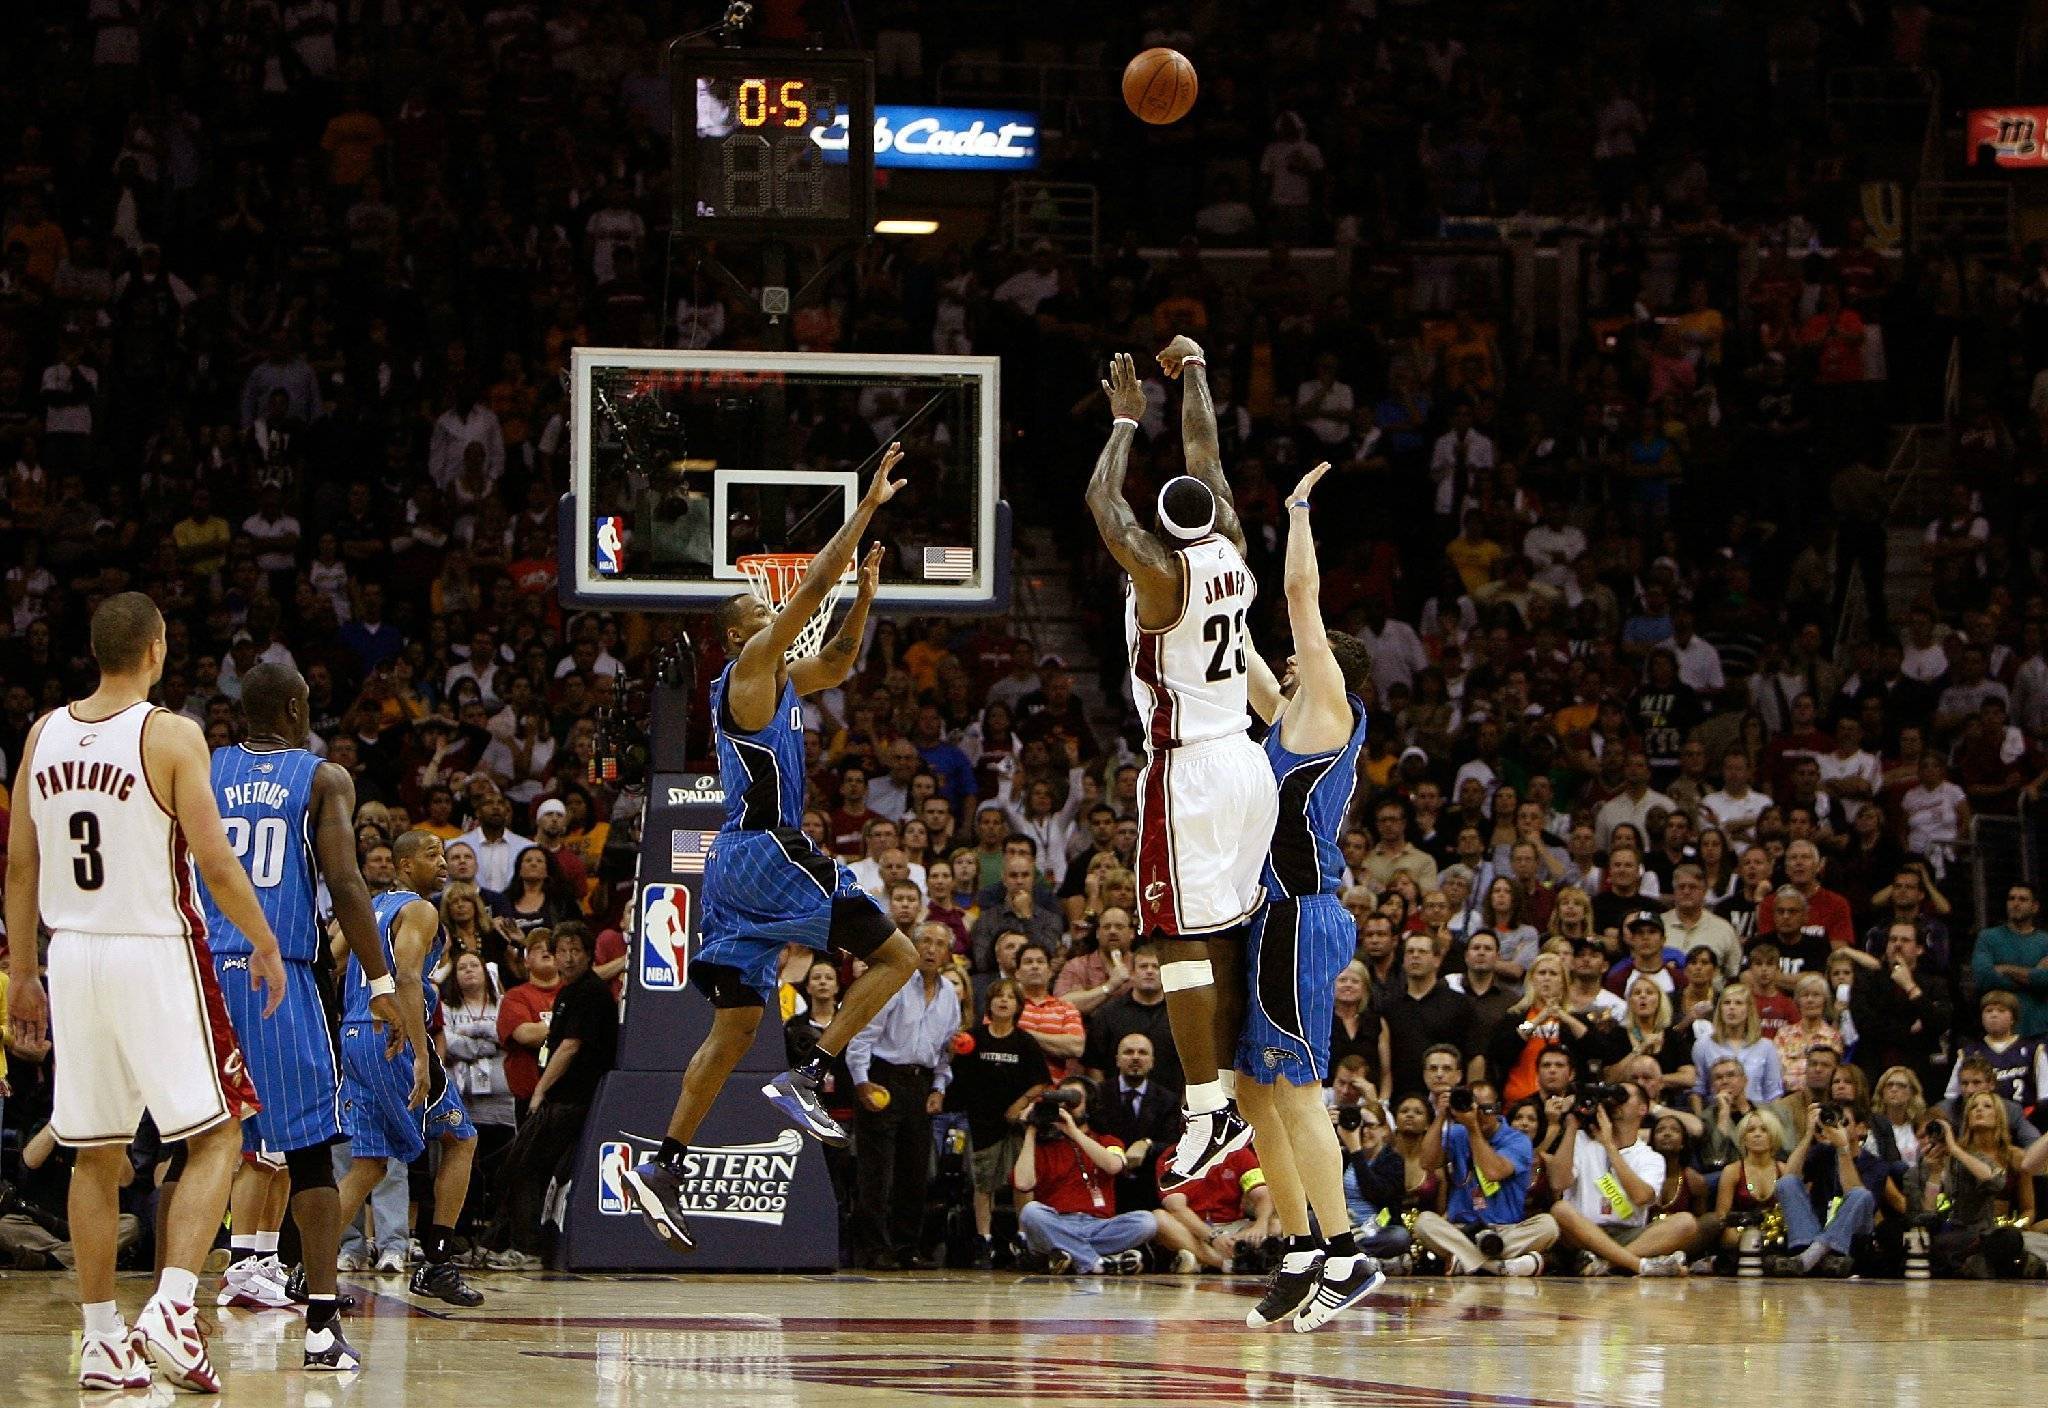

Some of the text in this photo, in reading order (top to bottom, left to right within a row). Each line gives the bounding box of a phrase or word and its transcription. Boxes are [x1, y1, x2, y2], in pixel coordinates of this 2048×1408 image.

[738, 80, 807, 127] 0.5
[810, 114, 1035, 157] Cb Cadet
[1204, 570, 1246, 605] JAMES
[1203, 607, 1247, 683] 23
[35, 761, 136, 802] PAVLOVIC
[224, 780, 290, 810] PIETRUS
[69, 810, 104, 891] 3
[645, 966, 673, 982] NBA
[638, 1151, 797, 1180] ESTERN
[679, 1179, 790, 1195] FERENCE
[602, 1198, 621, 1209] NBA
[724, 1195, 787, 1212] 2009
